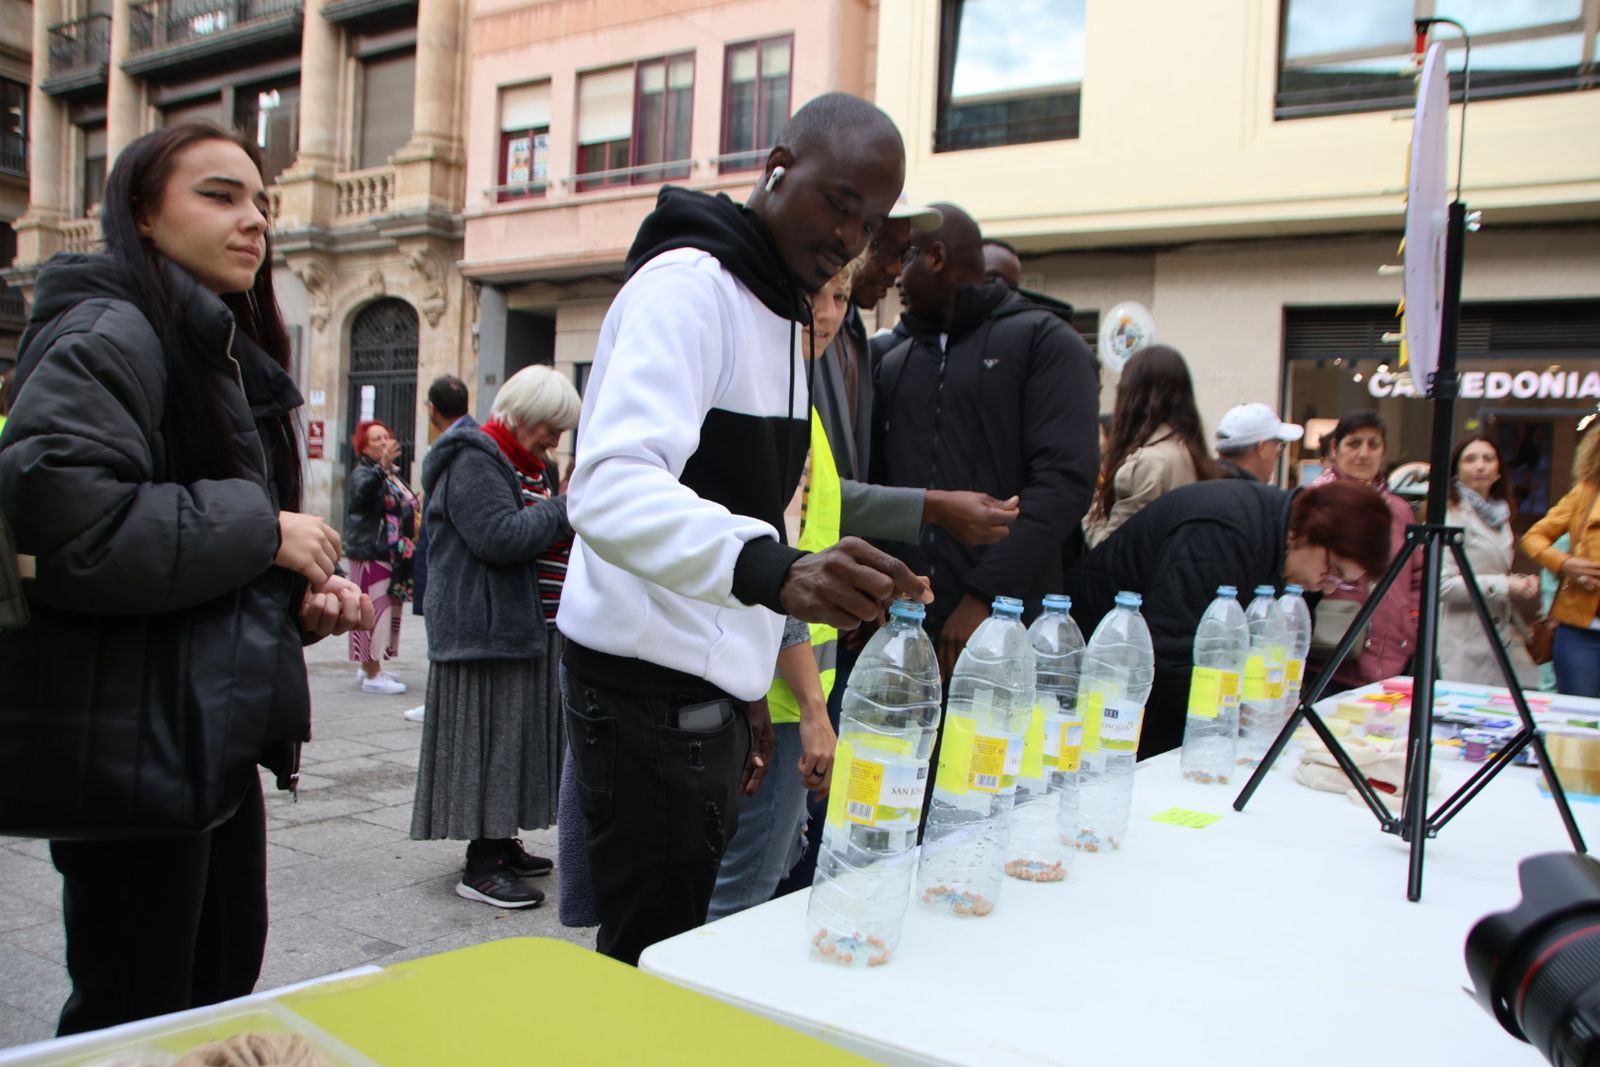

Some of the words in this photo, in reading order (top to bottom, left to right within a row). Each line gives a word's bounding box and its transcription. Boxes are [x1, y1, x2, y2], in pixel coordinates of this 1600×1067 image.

[1367, 370, 1600, 399] CAEDONIA
[1100, 722, 1130, 730] OAQUIN
[891, 785, 909, 796] SAN
